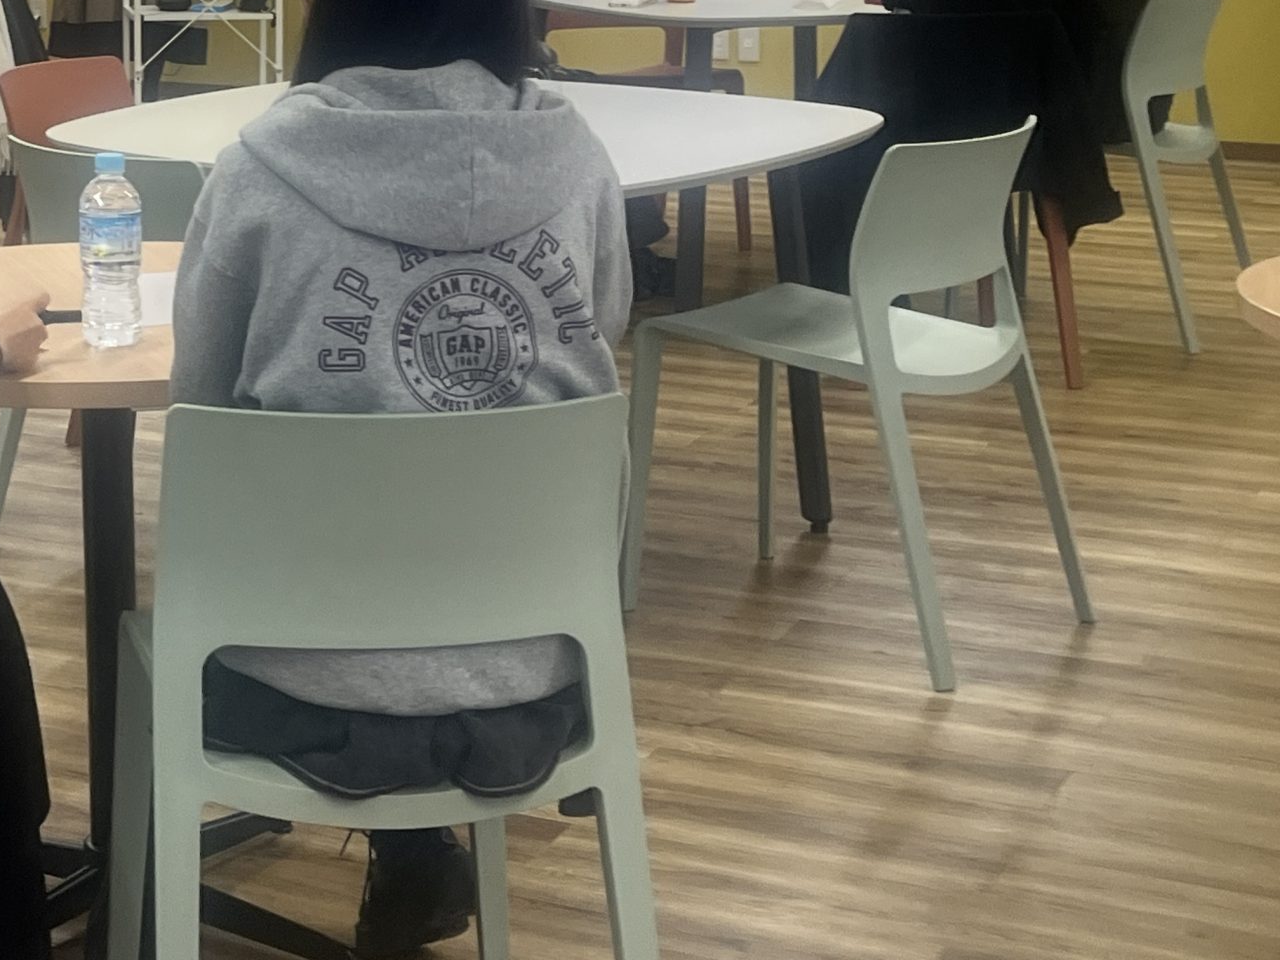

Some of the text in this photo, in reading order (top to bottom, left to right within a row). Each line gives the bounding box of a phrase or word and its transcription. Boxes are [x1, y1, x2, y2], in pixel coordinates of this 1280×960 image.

[318, 266, 380, 373] GAP
[398, 277, 462, 349] AMERICAN
[470, 277, 528, 334] CLASSIC
[446, 334, 486, 356] GAP
[454, 355, 480, 368] 1969
[430, 390, 470, 412] FINEST
[473, 378, 517, 411] QUALITY
